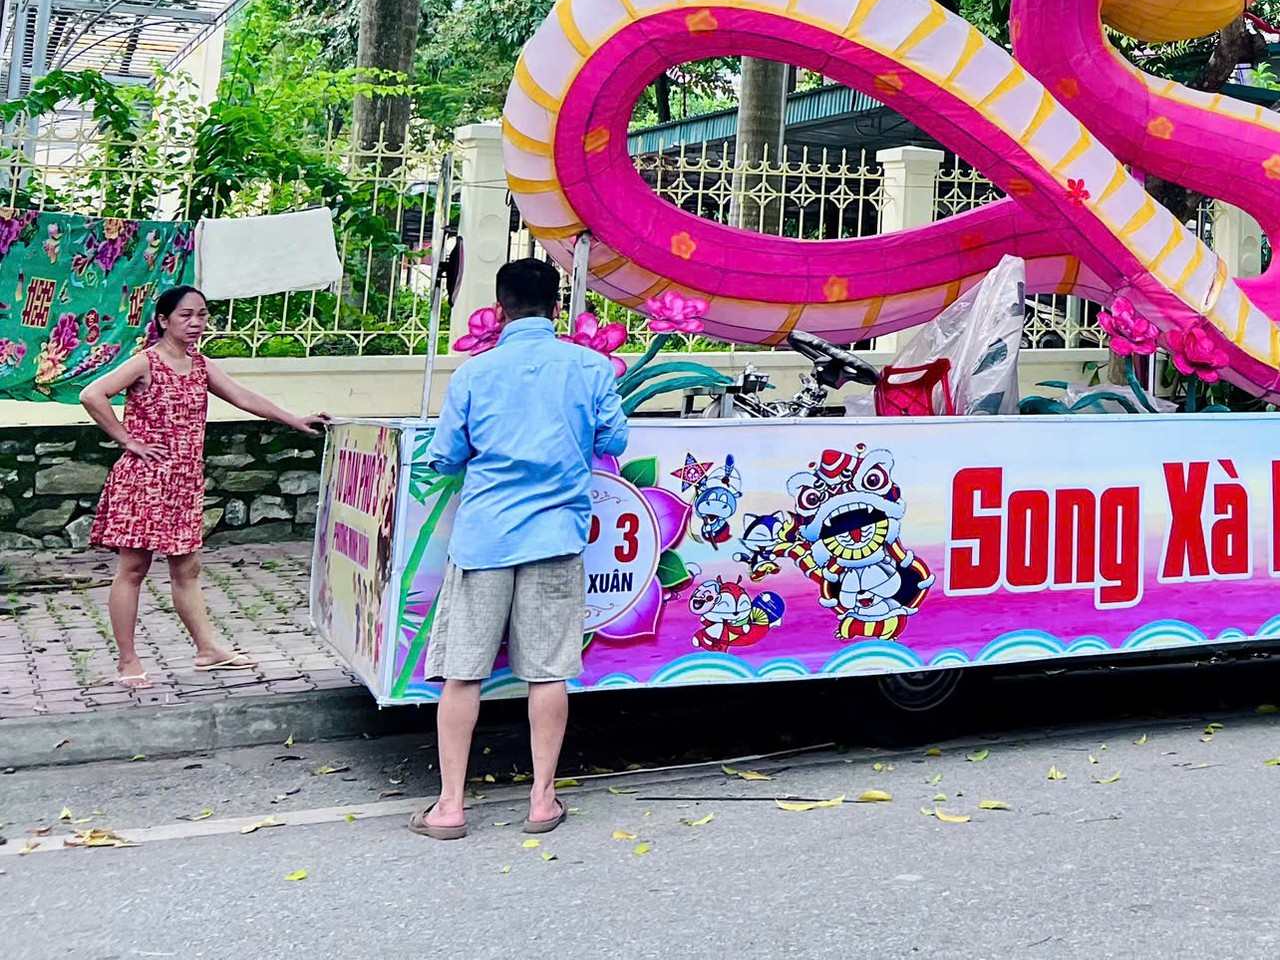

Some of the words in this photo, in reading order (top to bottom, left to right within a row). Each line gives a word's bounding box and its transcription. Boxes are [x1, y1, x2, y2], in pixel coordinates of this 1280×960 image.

[613, 512, 640, 564] 3
[949, 466, 1140, 605] Song
[1161, 458, 1249, 579] Xà
[586, 568, 634, 594] XUÂN
